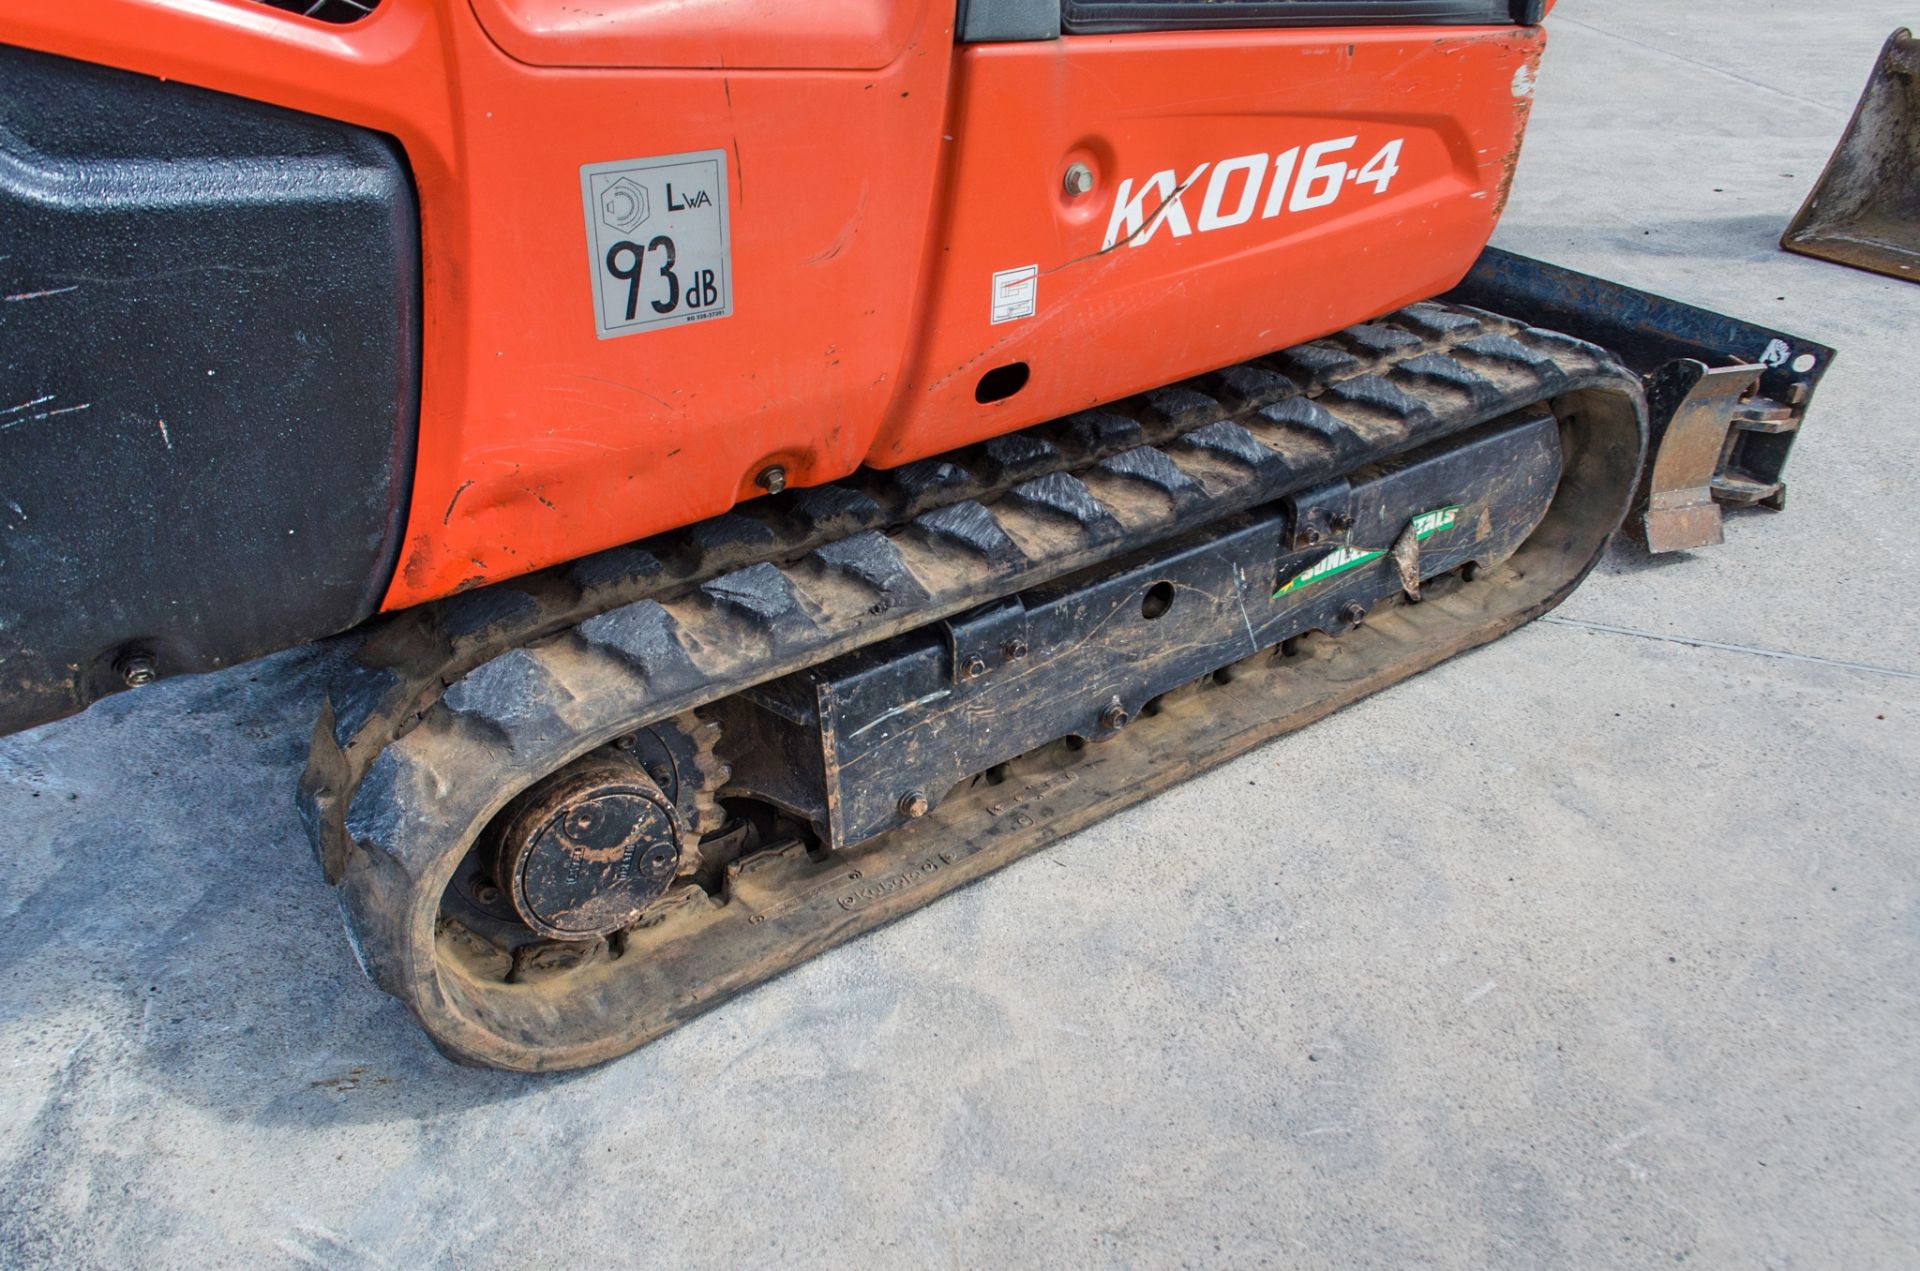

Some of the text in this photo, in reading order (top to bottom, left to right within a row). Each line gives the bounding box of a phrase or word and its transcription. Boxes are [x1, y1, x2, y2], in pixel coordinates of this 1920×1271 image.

[1101, 136, 1404, 252] KX016-4
[606, 235, 717, 321] 93 dB
